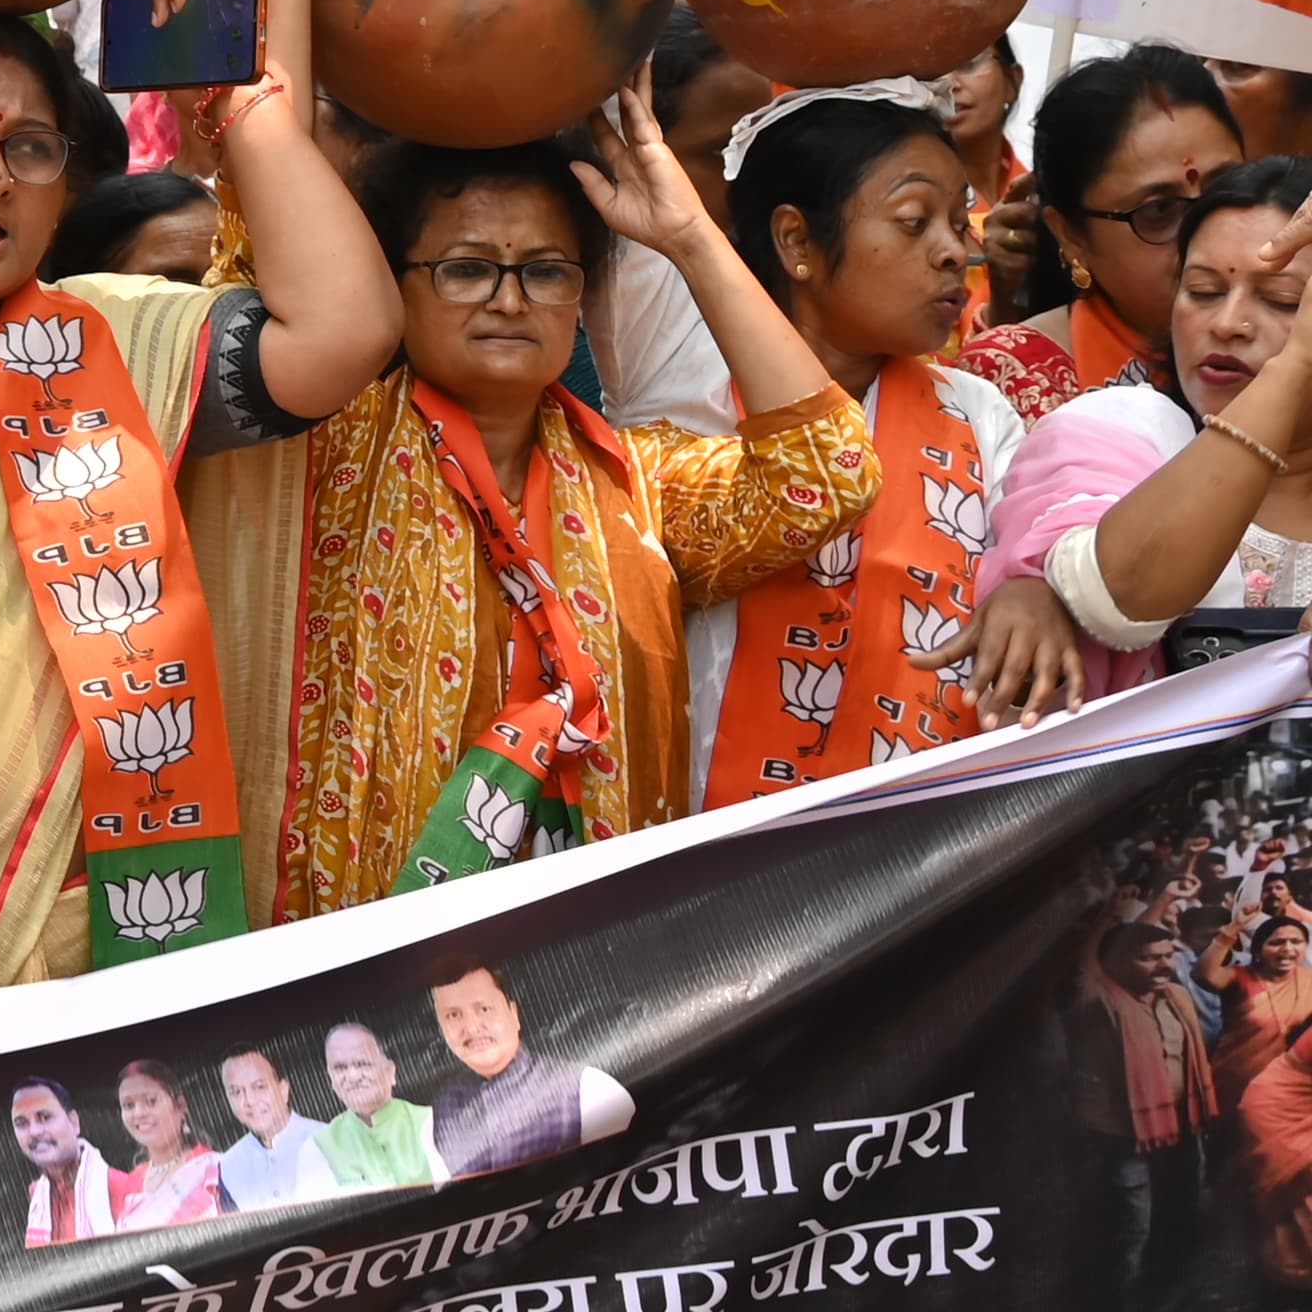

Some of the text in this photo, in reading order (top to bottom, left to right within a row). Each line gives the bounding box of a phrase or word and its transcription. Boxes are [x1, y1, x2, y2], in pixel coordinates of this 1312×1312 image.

[256, 1196, 543, 1312] खिलाफ
[547, 1126, 799, 1233] भाजपा
[813, 1091, 976, 1203] द्वारा
[749, 1207, 1002, 1300] जोरदार
